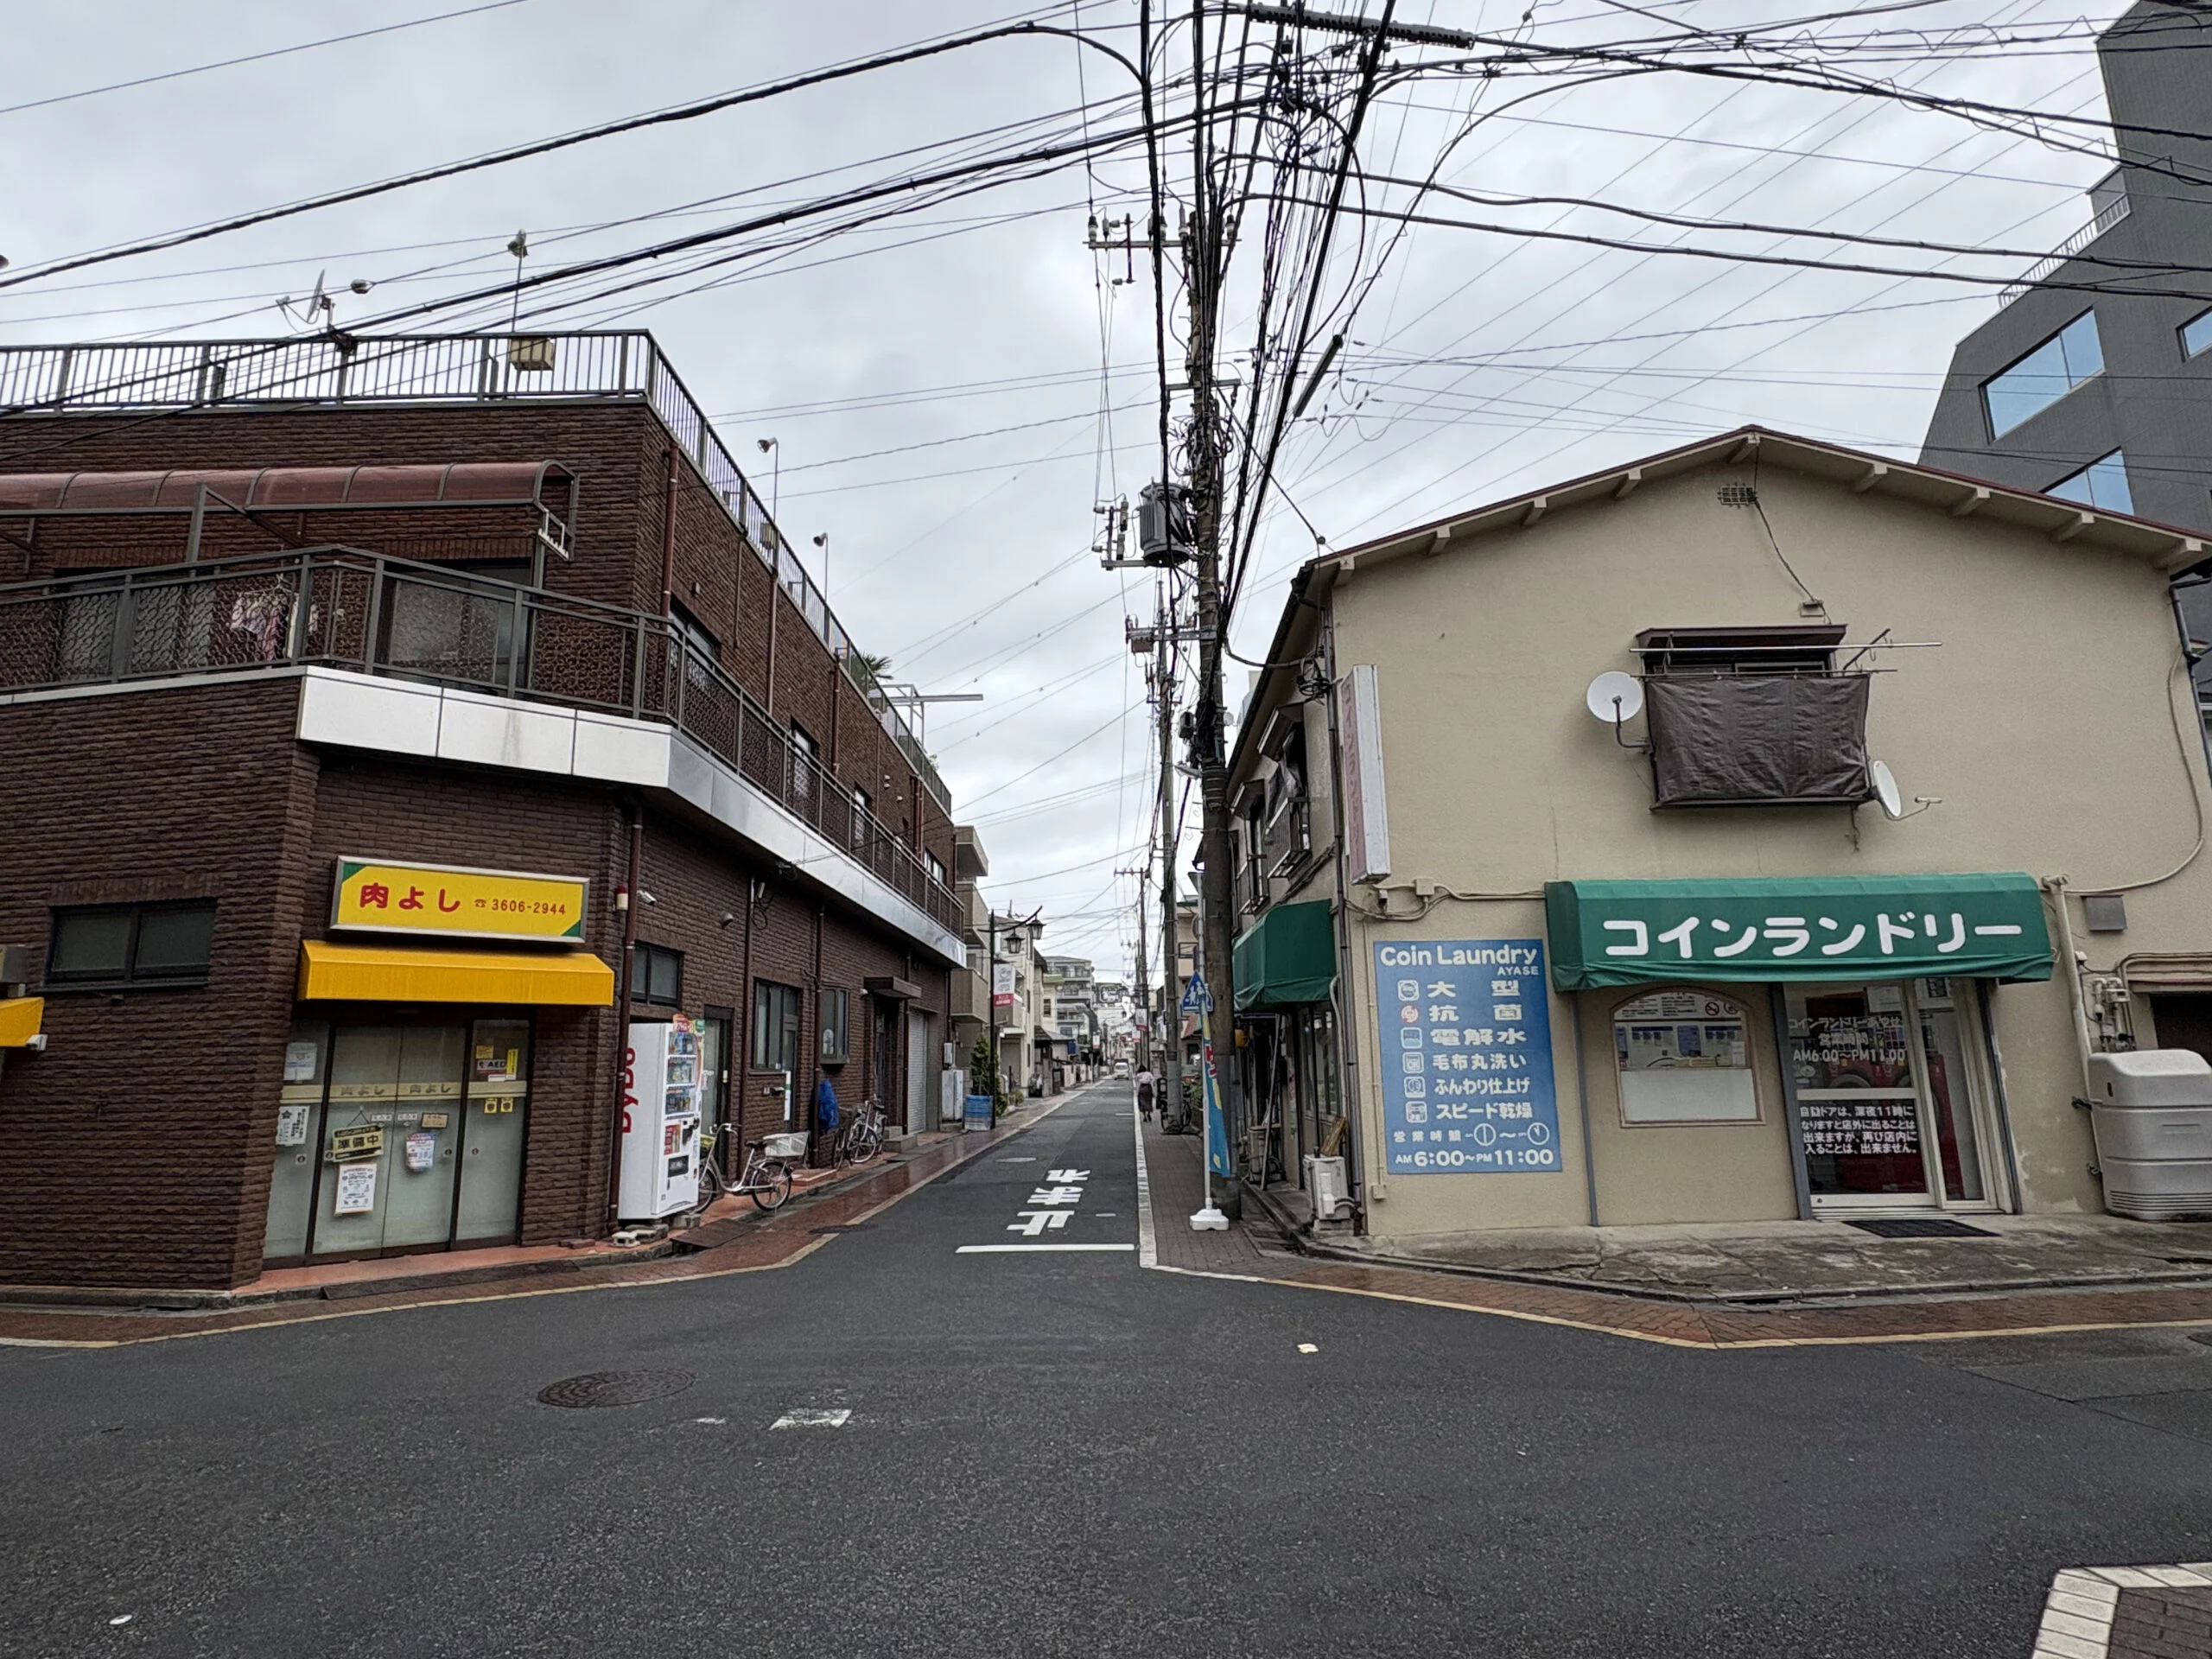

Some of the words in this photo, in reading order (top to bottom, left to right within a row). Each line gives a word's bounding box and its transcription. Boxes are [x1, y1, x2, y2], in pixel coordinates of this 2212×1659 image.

[359, 882, 461, 912] 肉よし
[492, 900, 566, 915] 3606-2944
[1603, 911, 2023, 958] コインランドリー
[1380, 945, 1432, 966] Coin
[1438, 944, 1537, 966] Laundry
[1497, 966, 1539, 976] AYASE
[1431, 1028, 1527, 1046] 電解水
[1433, 1054, 1527, 1071] 毛布丸洗い
[1434, 1077, 1530, 1096] ふんわり仕上げ
[1436, 1103, 1534, 1120] スピード乾燥
[338, 1135, 379, 1149] 準備中
[1006, 1168, 1091, 1236] 止まれ
